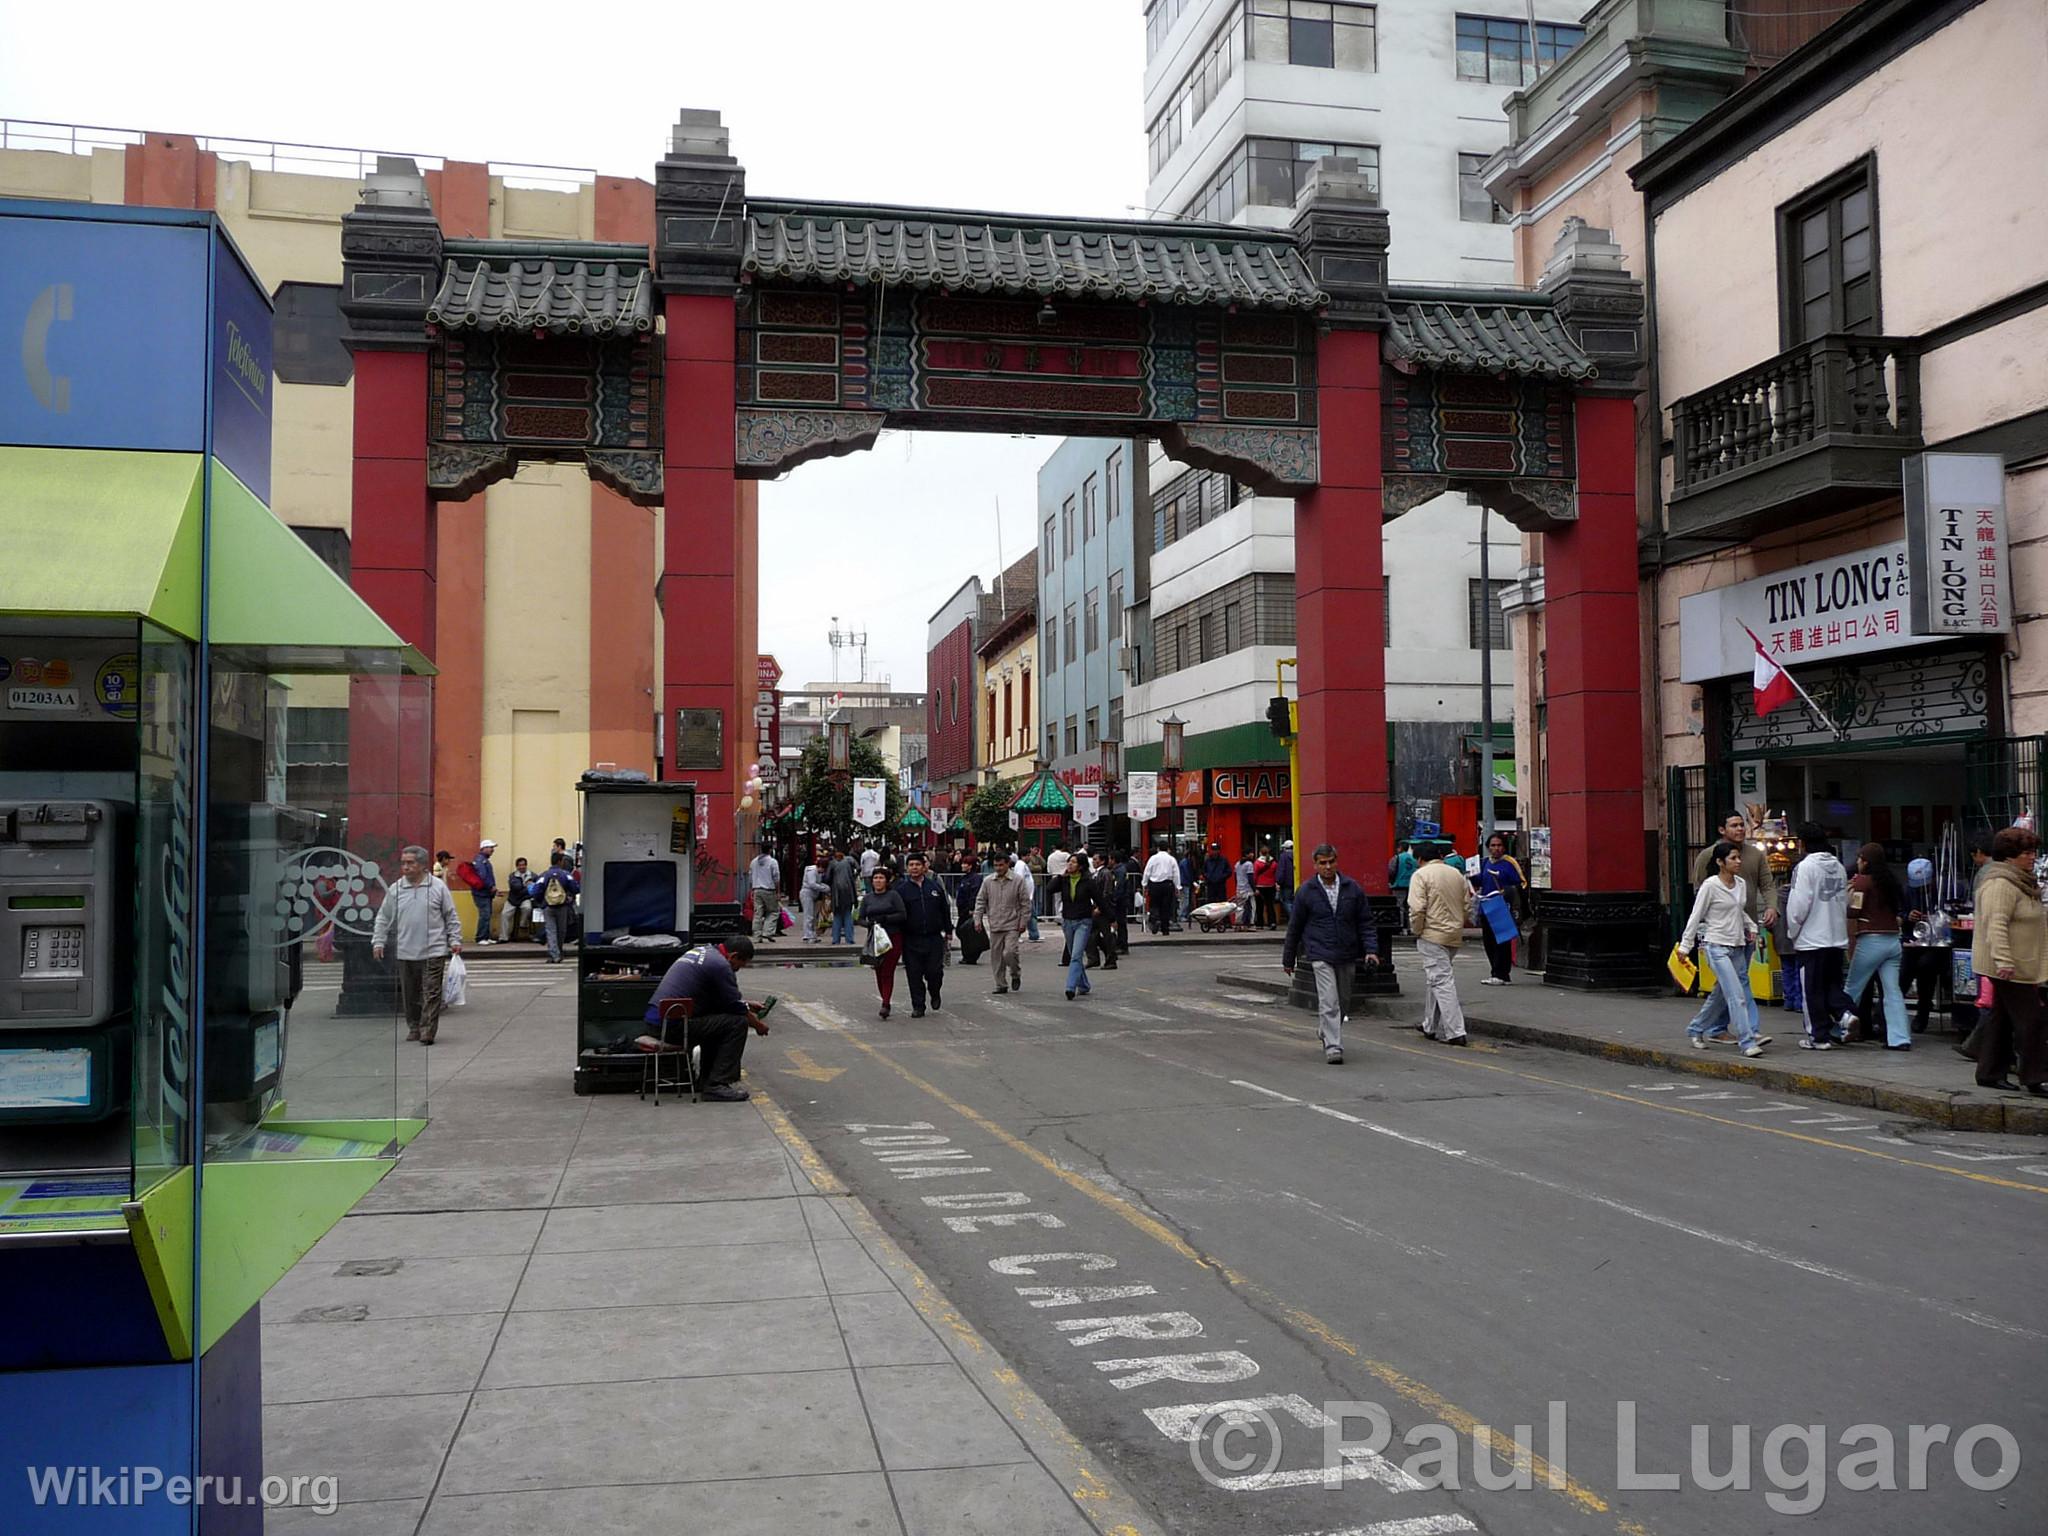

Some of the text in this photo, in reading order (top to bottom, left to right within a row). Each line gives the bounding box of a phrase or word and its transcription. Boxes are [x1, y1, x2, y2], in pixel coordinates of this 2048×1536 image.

[1940, 508, 1964, 552] TIN
[1764, 576, 1807, 625] TIN
[1815, 556, 1890, 613] LONG
[1941, 559, 1968, 617] LONG
[1975, 509, 1999, 628] 天龍進出口公司
[1770, 608, 1902, 656] 天龍進出口公司
[12, 692, 75, 705] 01203AA
[756, 691, 777, 767] BOTICA
[1215, 771, 1291, 800] CHAP
[844, 1120, 992, 1181] ZONA
[920, 1190, 1066, 1234] DE
